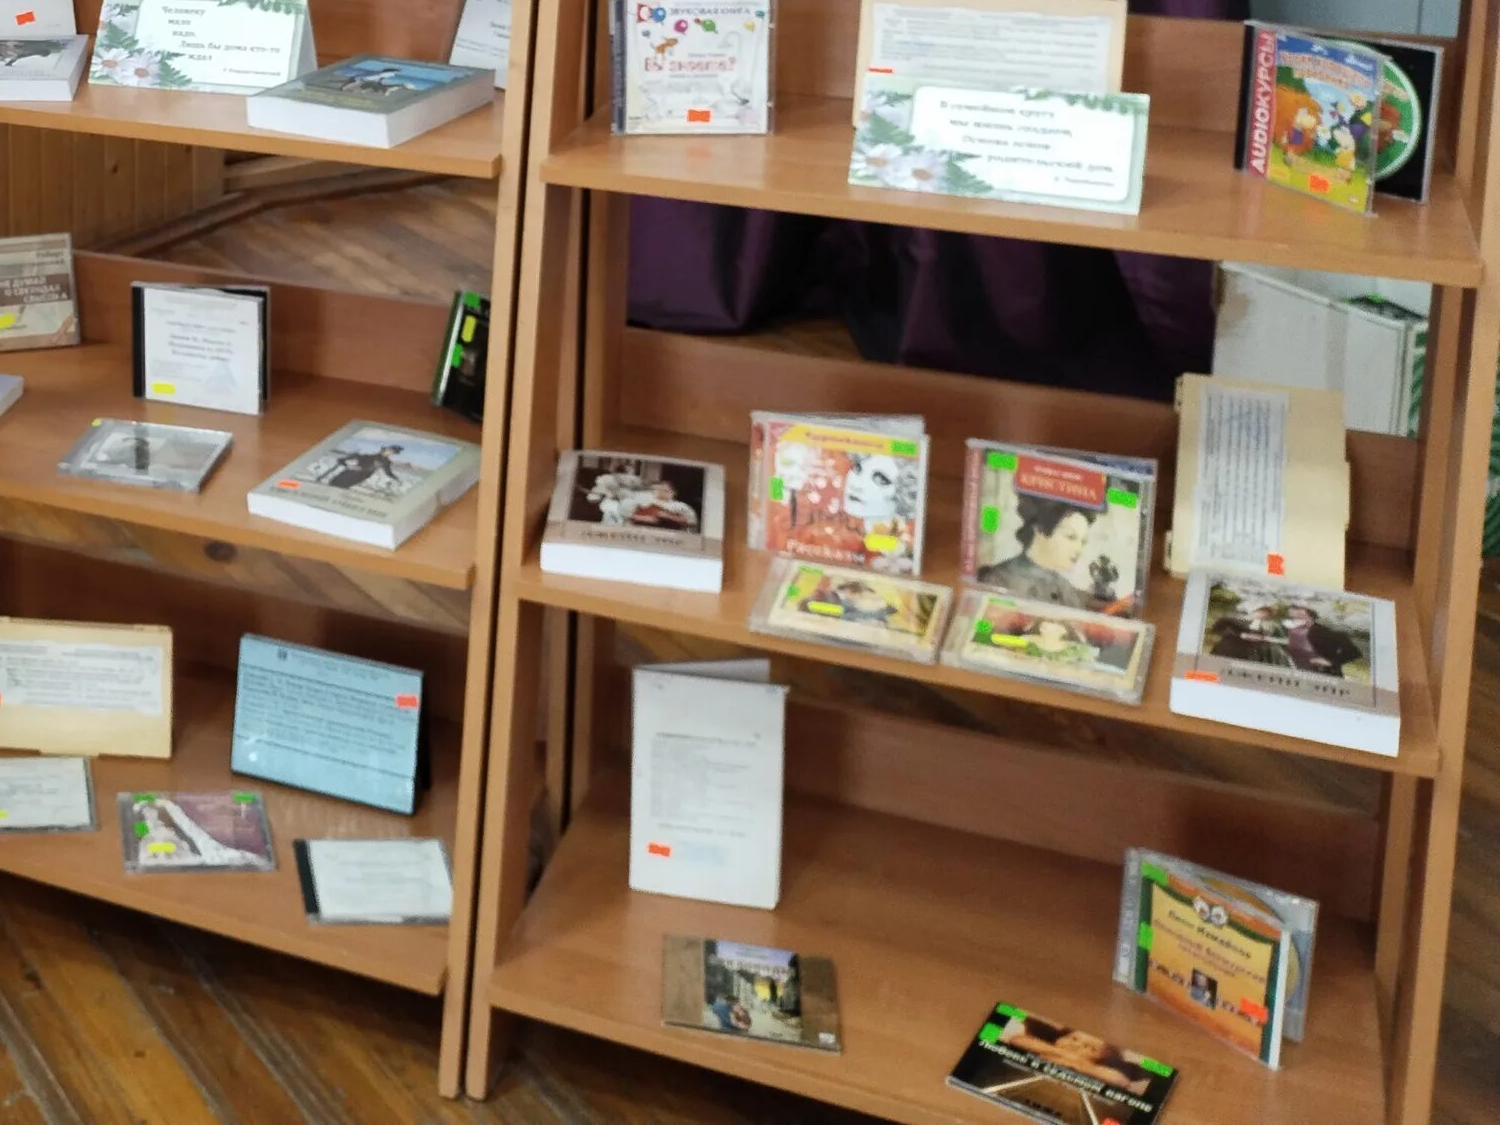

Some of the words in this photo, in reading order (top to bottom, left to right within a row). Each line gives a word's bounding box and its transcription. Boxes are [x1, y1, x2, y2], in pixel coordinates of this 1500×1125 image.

[161, 5, 206, 17] Человеку
[179, 40, 206, 49] Лишь
[207, 41, 221, 50] бы
[223, 44, 248, 53] дома
[249, 45, 280, 54] кто-то
